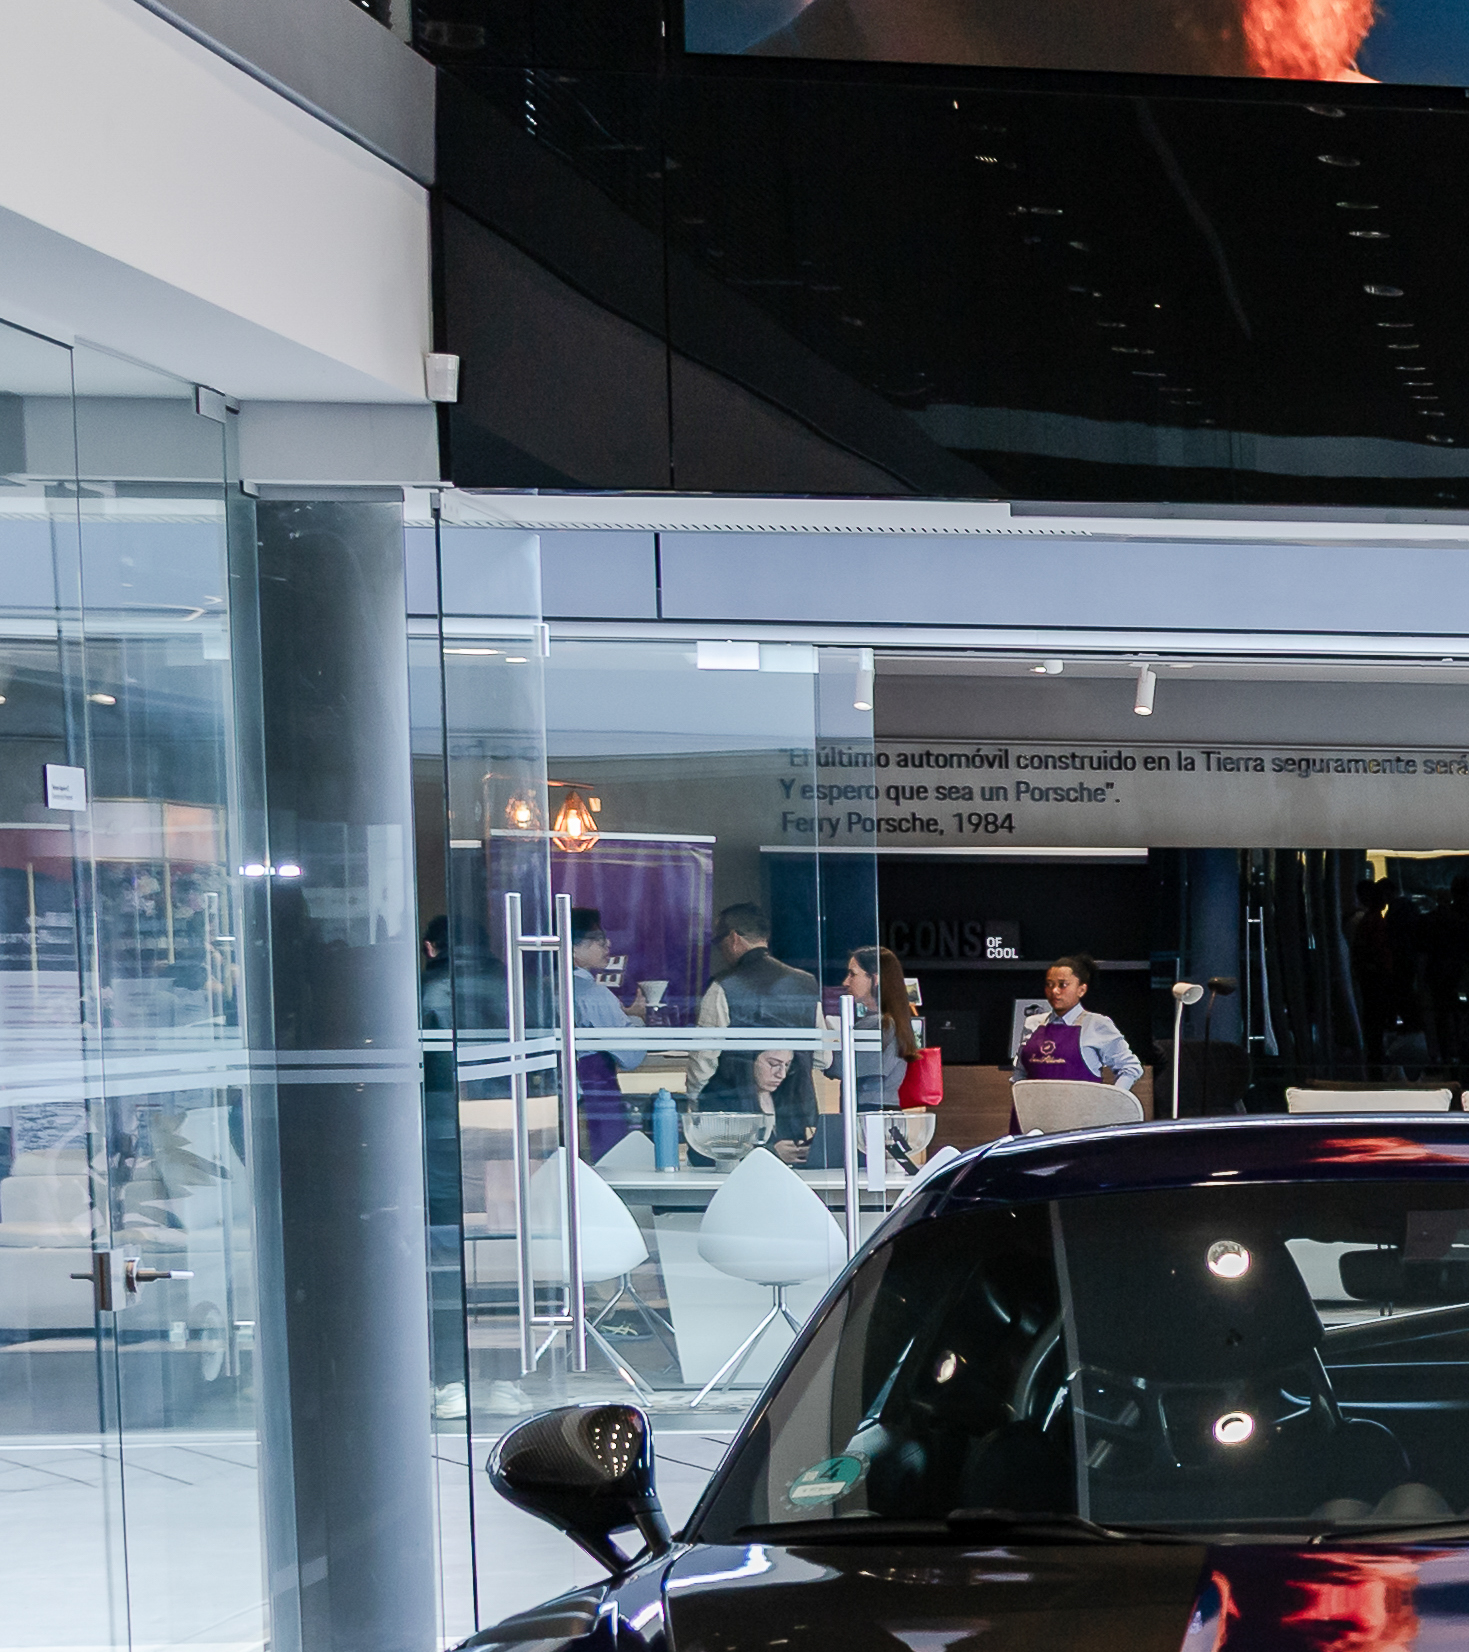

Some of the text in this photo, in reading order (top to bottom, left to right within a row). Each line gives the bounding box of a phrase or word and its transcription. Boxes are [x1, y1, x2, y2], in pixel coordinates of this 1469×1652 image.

[816, 748, 890, 770] último
[896, 747, 1010, 770] automóvil
[1016, 749, 1137, 771] construido
[1143, 756, 1170, 772] en
[1176, 750, 1196, 772] la
[1202, 750, 1265, 773] Tierra
[1271, 755, 1417, 778] seguramente
[1423, 755, 1469, 776] será
[779, 778, 796, 800] Y
[801, 784, 880, 805] espero
[886, 784, 928, 806] que
[935, 785, 974, 801] sea
[980, 785, 1008, 802] un
[781, 811, 1016, 839] Ferry Porsche, 1984
[986, 936, 1002, 948] OF
[986, 947, 1019, 959] COOL
